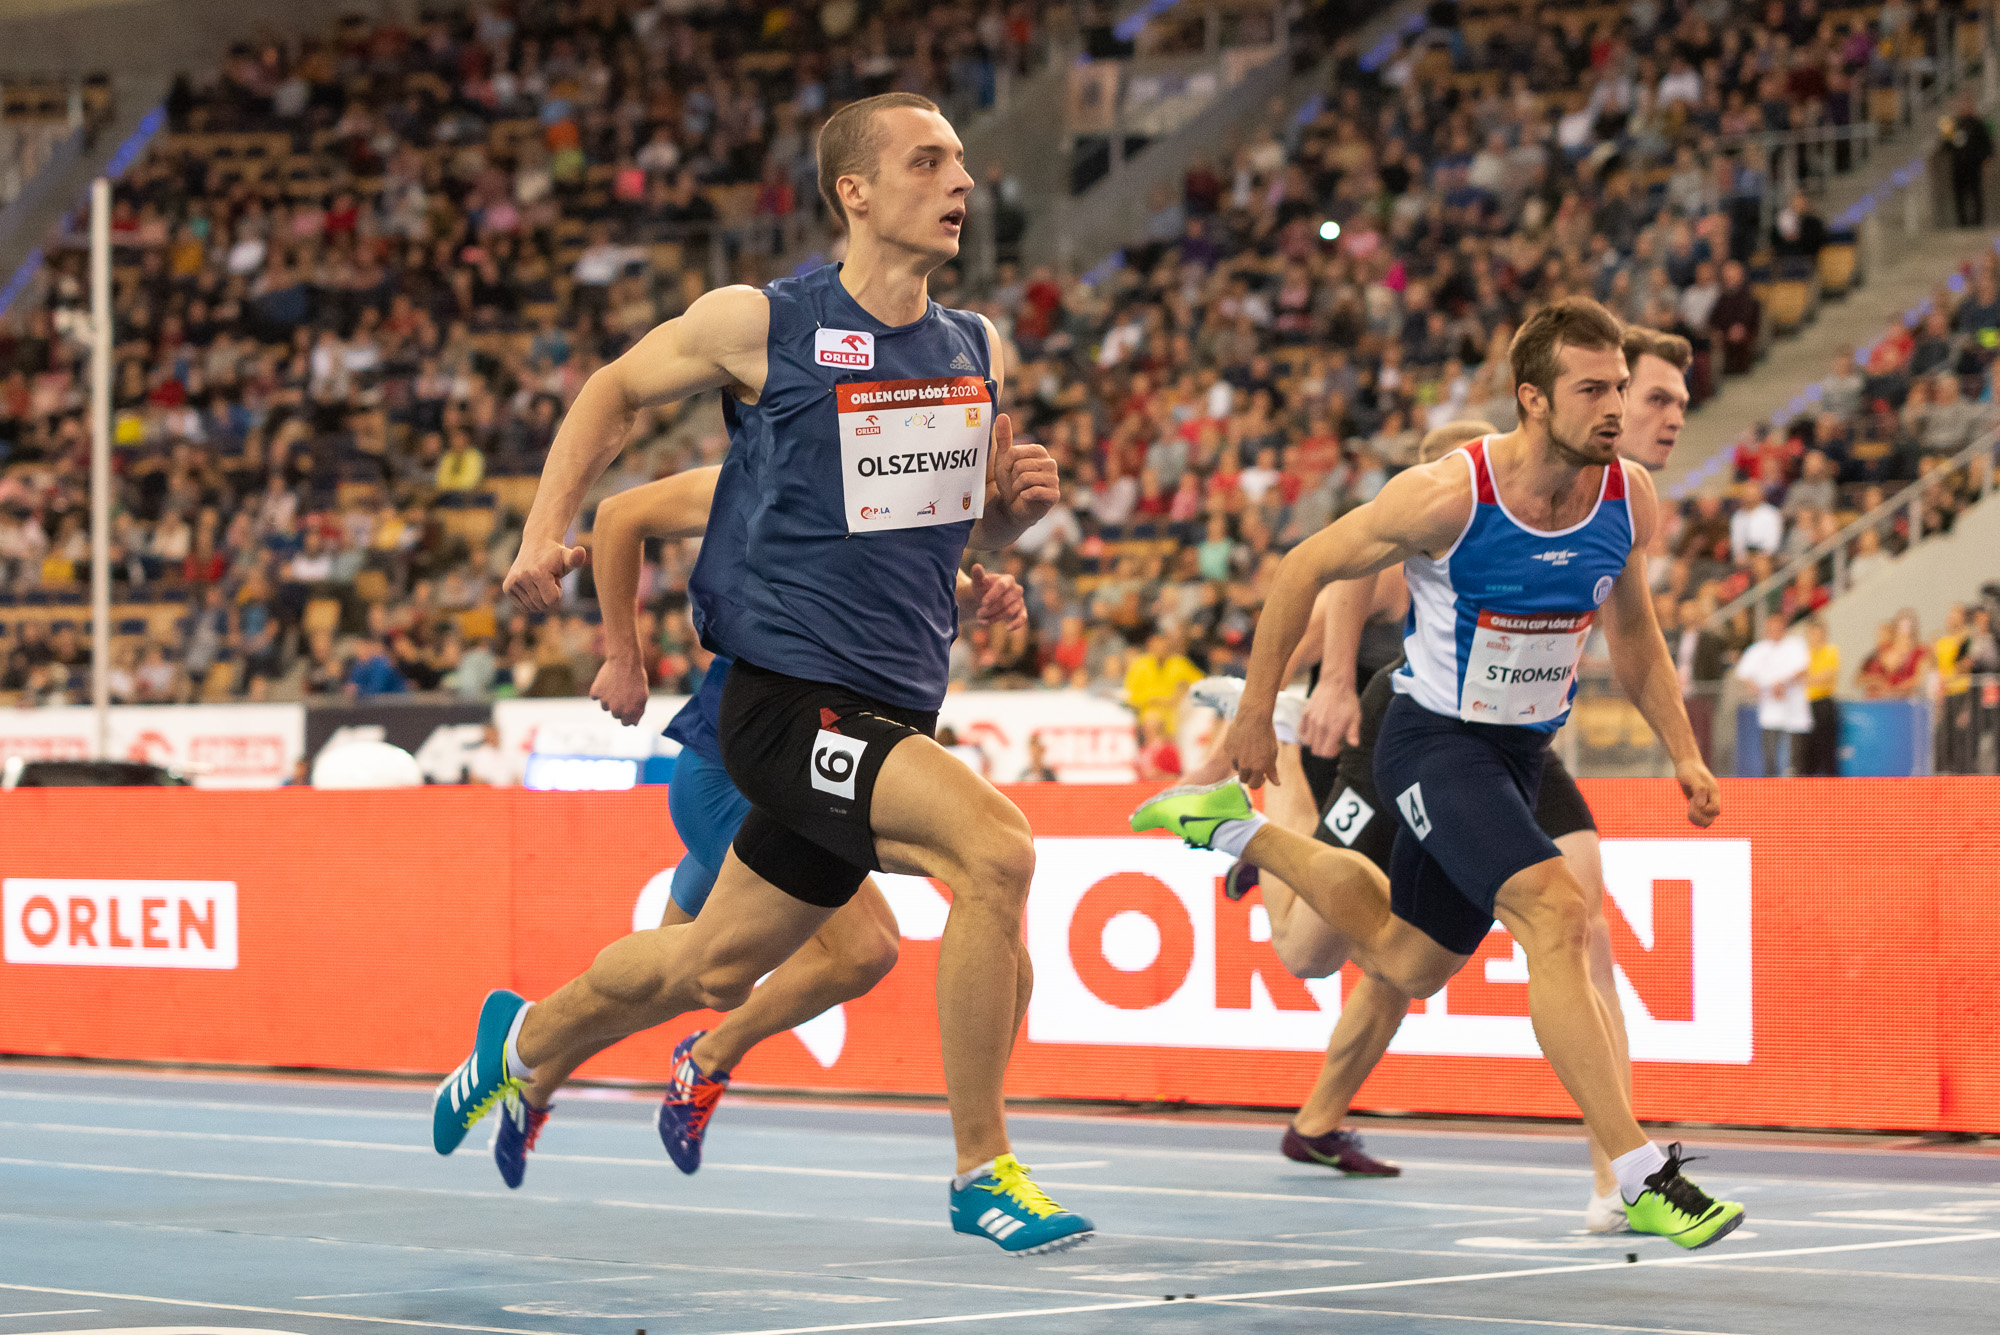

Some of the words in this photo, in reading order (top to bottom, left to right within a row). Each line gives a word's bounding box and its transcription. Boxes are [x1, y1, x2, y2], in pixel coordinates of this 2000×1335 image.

[823, 352, 866, 364] ORLEN
[950, 362, 976, 371] adidas
[850, 390, 892, 405] ORLEN
[893, 388, 918, 402] CUP
[919, 384, 950, 400] ŁÓDŹ
[950, 385, 978, 398] 2020
[856, 427, 880, 436] ORLEN
[857, 448, 978, 477] OLSZEWSKI
[1490, 616, 1528, 629] ORLEN
[1528, 619, 1548, 630] CUP
[814, 746, 855, 783] 6
[1335, 801, 1360, 832] 3
[1409, 791, 1426, 831] 4
[21, 894, 216, 950] ORLEN
